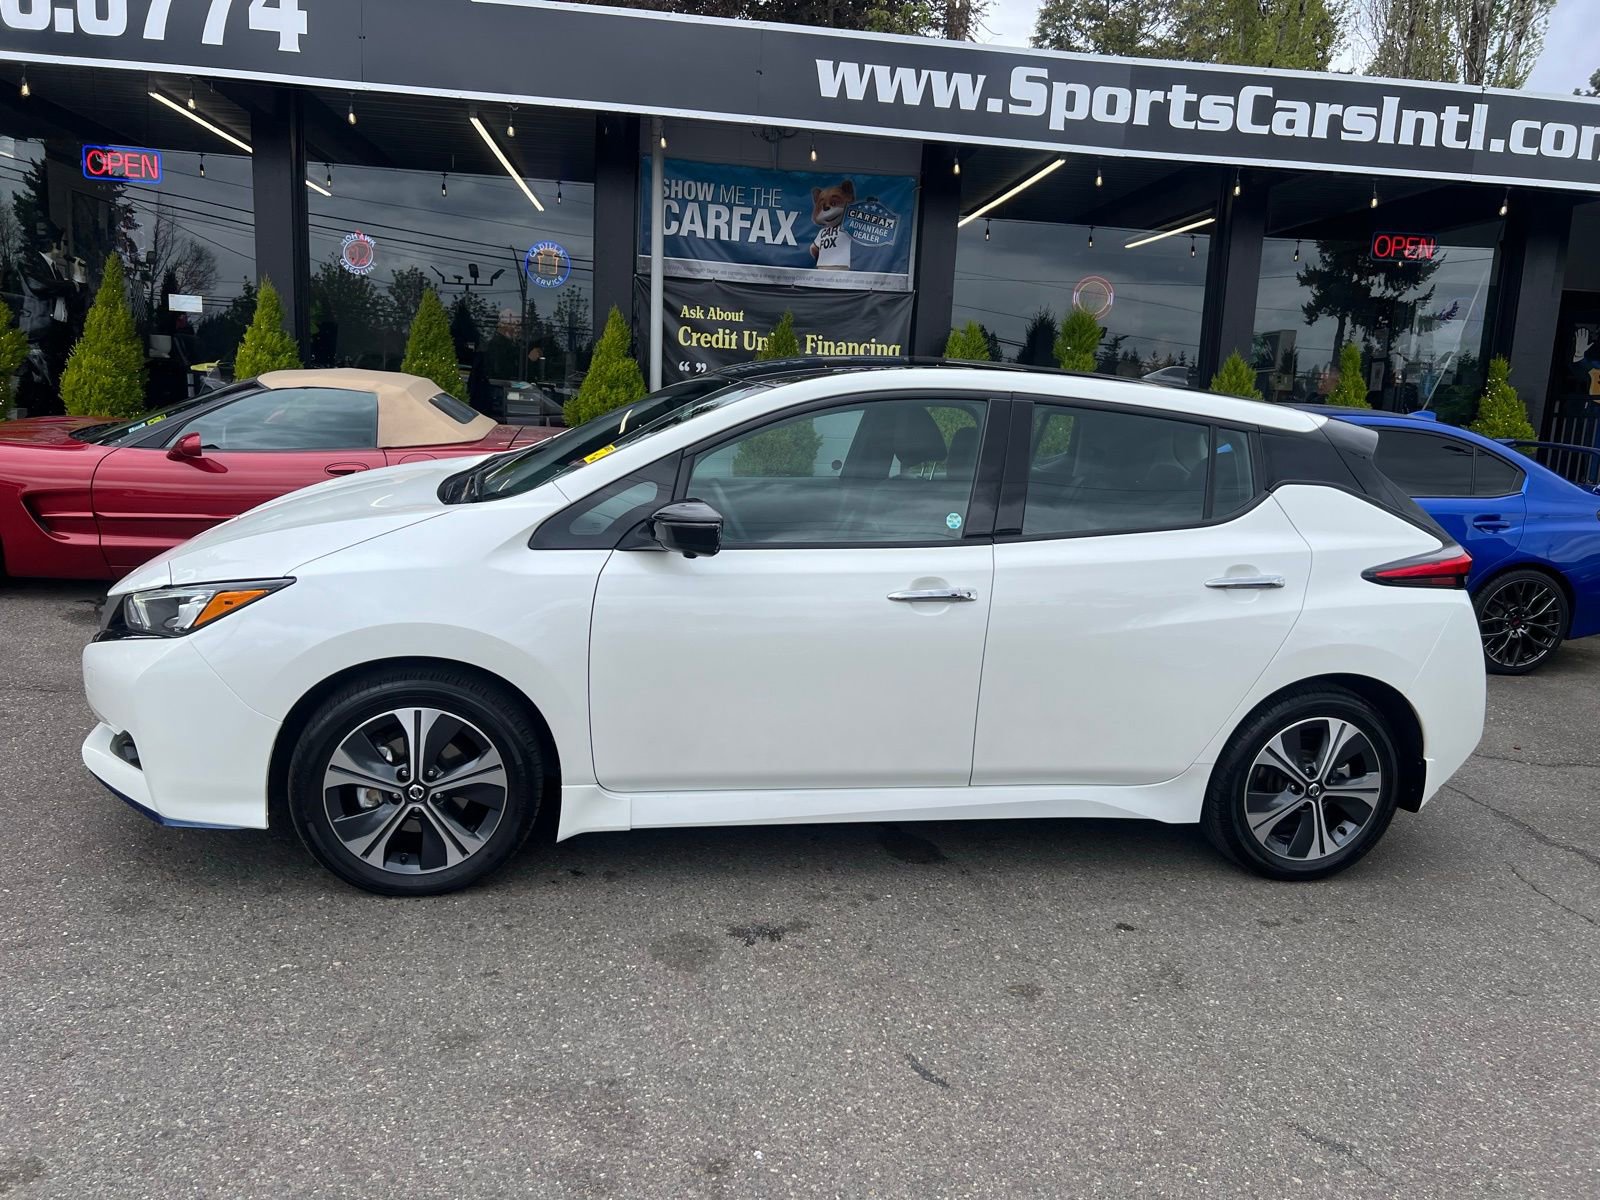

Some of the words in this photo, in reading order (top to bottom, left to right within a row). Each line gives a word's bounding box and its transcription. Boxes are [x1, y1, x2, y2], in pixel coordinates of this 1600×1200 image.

[87, 150, 159, 179] OPEN
[719, 184, 746, 205] ME
[750, 187, 782, 208] THE
[848, 209, 895, 229] CARFAX
[820, 226, 839, 239] CAR
[849, 219, 888, 237] ADVANTAGE
[341, 232, 376, 247] MOHAWK
[820, 237, 837, 249] FOX
[853, 230, 880, 244] DEALER
[1374, 235, 1434, 259] OPEN
[340, 258, 377, 275] GASOLINE
[680, 305, 704, 319] Ask
[707, 307, 744, 322] About
[678, 325, 738, 350] Credit
